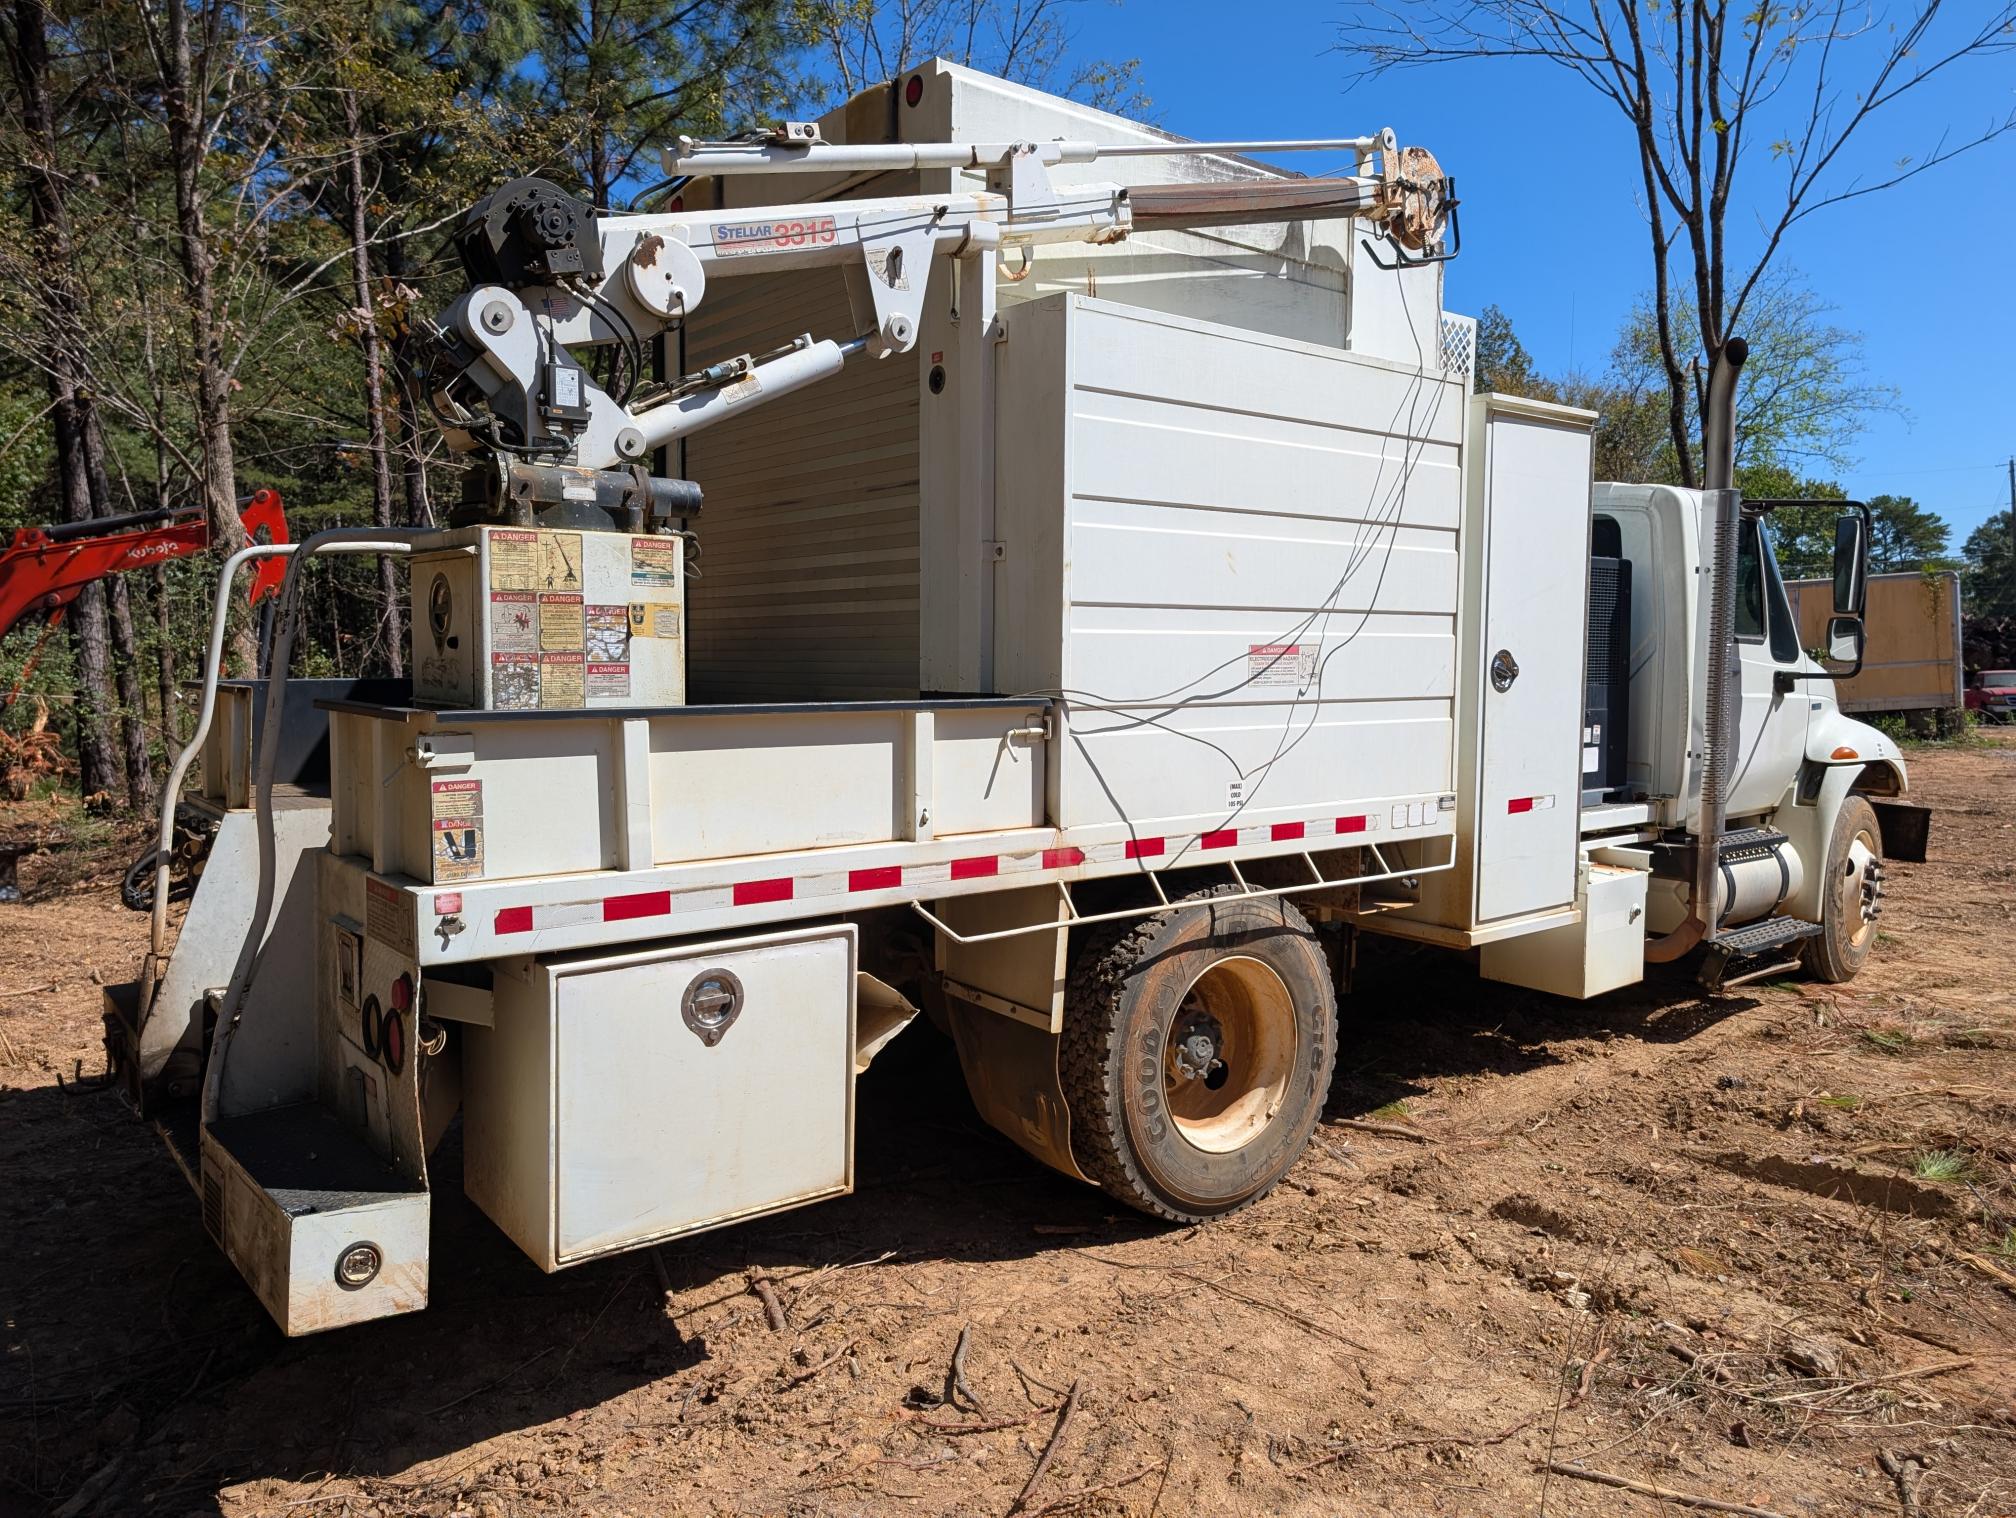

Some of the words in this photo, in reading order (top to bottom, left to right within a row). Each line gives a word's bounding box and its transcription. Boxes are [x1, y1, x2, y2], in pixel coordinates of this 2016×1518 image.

[717, 225, 772, 240] STELLAR
[774, 220, 836, 246] 3315
[501, 533, 536, 541] DANGER
[126, 541, 179, 558] Kubota
